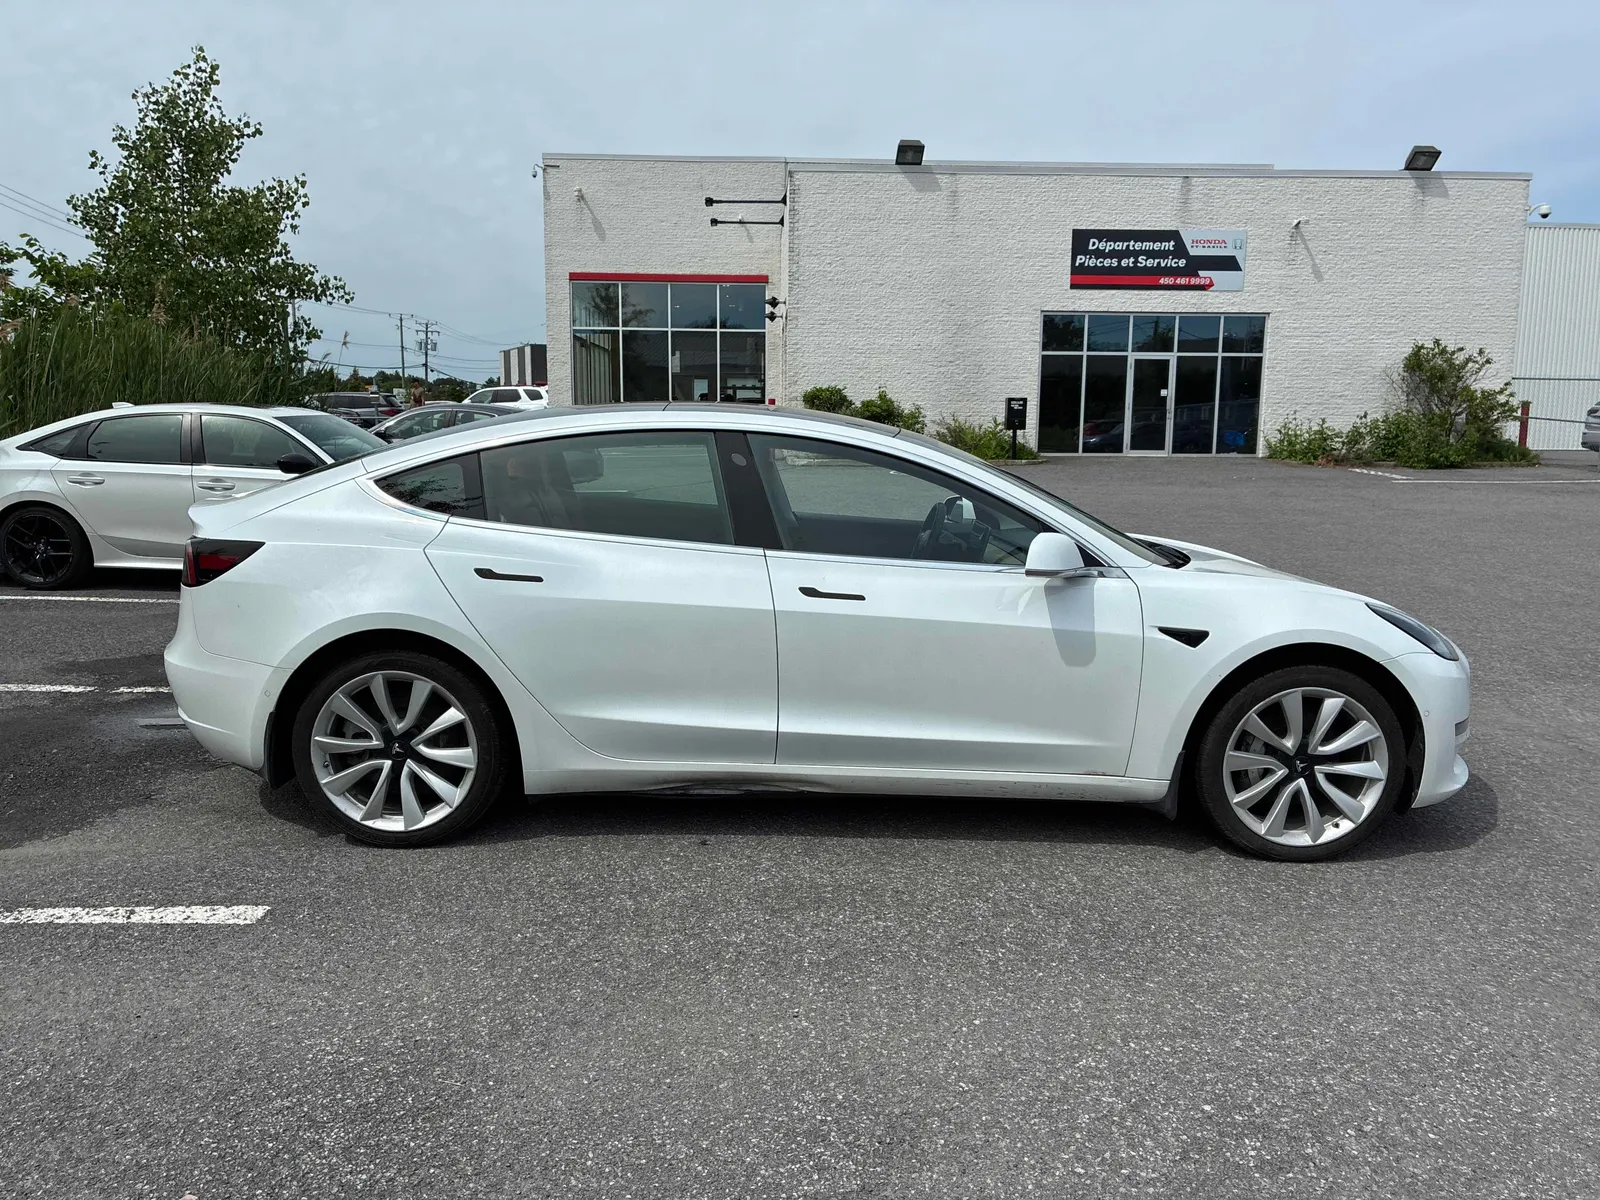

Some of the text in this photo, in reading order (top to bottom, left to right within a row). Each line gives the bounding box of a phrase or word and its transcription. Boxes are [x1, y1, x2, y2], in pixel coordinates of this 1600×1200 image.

[1088, 237, 1175, 252] Département
[1075, 254, 1187, 267] Pièces et Service
[1158, 277, 1210, 285] 450 461 9999
